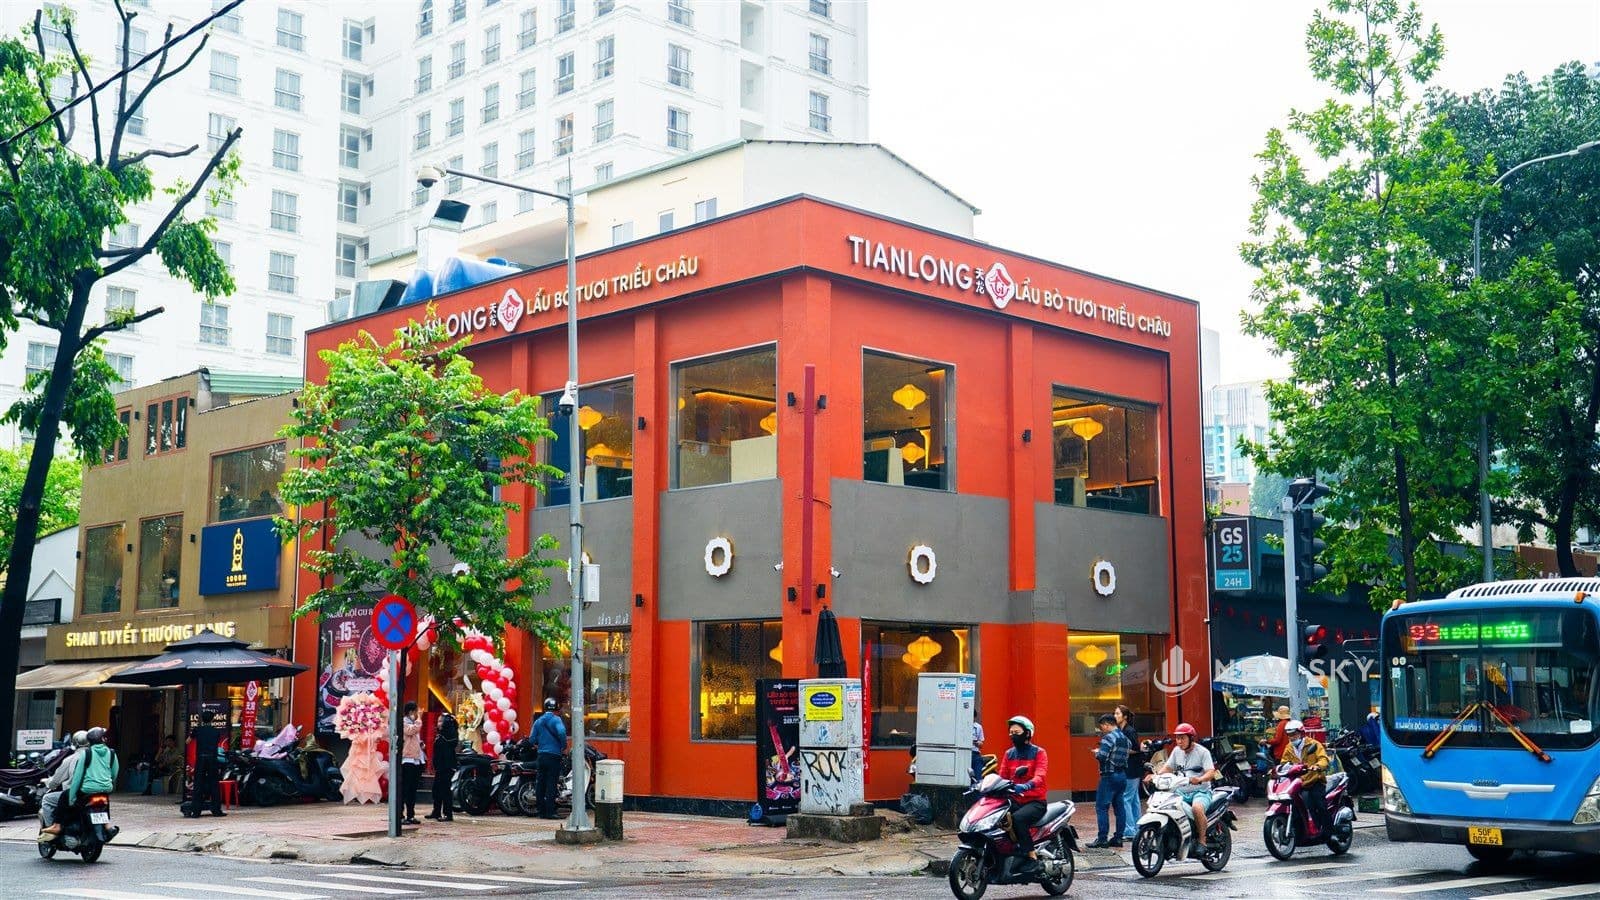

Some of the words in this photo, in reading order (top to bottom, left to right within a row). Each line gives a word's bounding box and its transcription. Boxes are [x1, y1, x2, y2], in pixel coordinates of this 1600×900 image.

[848, 235, 973, 290] TIANLONG
[575, 278, 608, 303] TƯƠI
[611, 263, 651, 294] TRIỀU
[656, 256, 699, 283] CHÂU
[1015, 279, 1041, 305] LẨU
[1044, 288, 1064, 310] BÒ
[1066, 296, 1098, 319] TƯƠI
[1099, 303, 1137, 329] TRIỀU
[1138, 315, 1171, 337] CHÂU
[1220, 527, 1243, 545] GS
[1222, 545, 1243, 563] 25
[1224, 577, 1242, 587] 24H
[66, 632, 99, 647] SHAN
[100, 622, 138, 645] TUYẾT
[1410, 625, 1439, 640] 93
